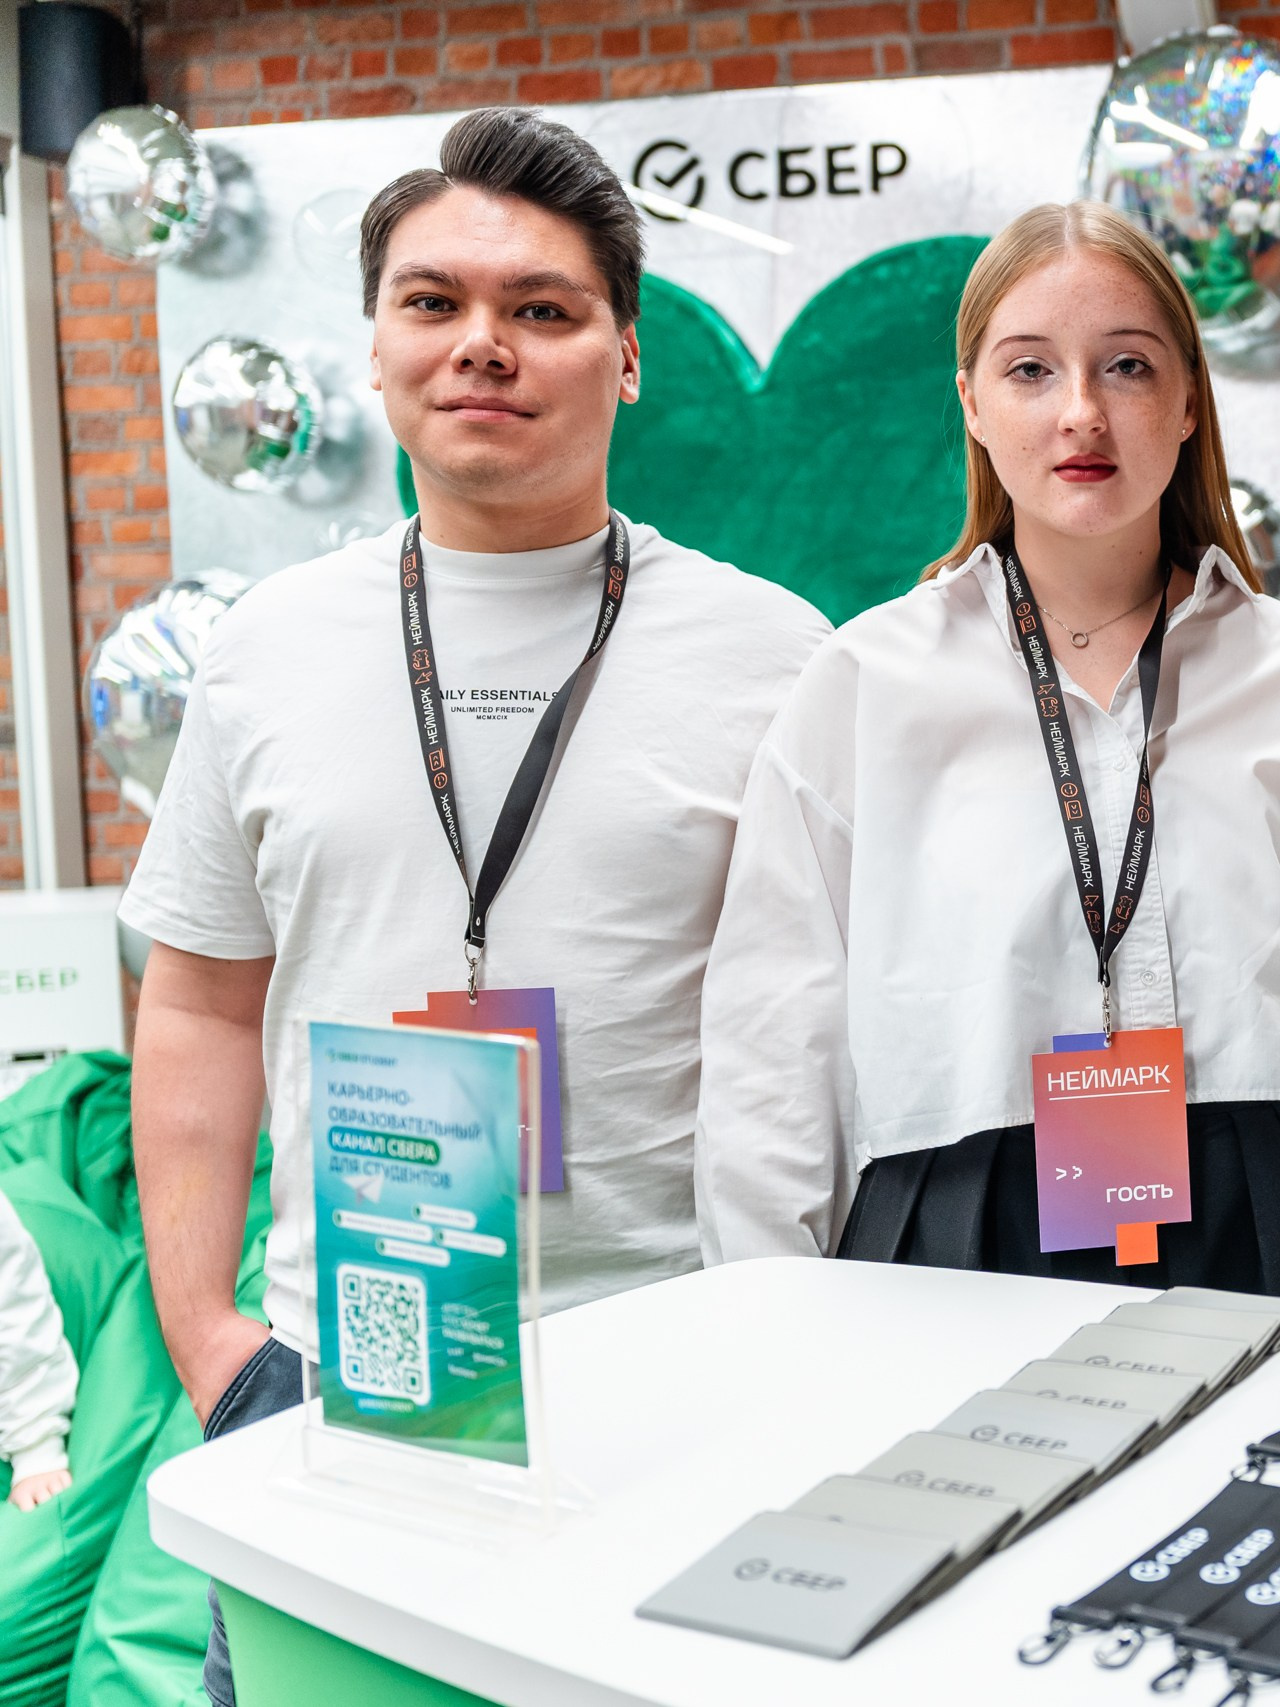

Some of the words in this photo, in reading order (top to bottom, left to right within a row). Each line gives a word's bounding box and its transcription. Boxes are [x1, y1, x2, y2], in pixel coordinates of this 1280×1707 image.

[729, 143, 907, 200] СБЕР
[1005, 556, 1024, 602] НЕЙМАРК
[407, 590, 424, 646] НЕЙМАРК
[1027, 635, 1048, 680] НЕЙМАРК
[420, 686, 439, 745] НЕЙМАРК
[439, 689, 466, 700] AILY
[1049, 721, 1071, 778] НЕЙМАРК
[440, 793, 460, 855] НЕЙМАРК
[1072, 825, 1094, 888] НЕЙМАРК
[1124, 827, 1146, 891] НЕЙМАРК
[1047, 1064, 1171, 1092] НЕЙМАРК
[327, 1106, 482, 1140] ОБРАЗОВАТЕЛЬНЫЙ
[331, 1132, 386, 1154] КАНАЛ
[386, 1138, 438, 1162] СБЕРА
[329, 1156, 360, 1174] ДЛЯ
[362, 1160, 452, 1189] СТУДЕНТОВ
